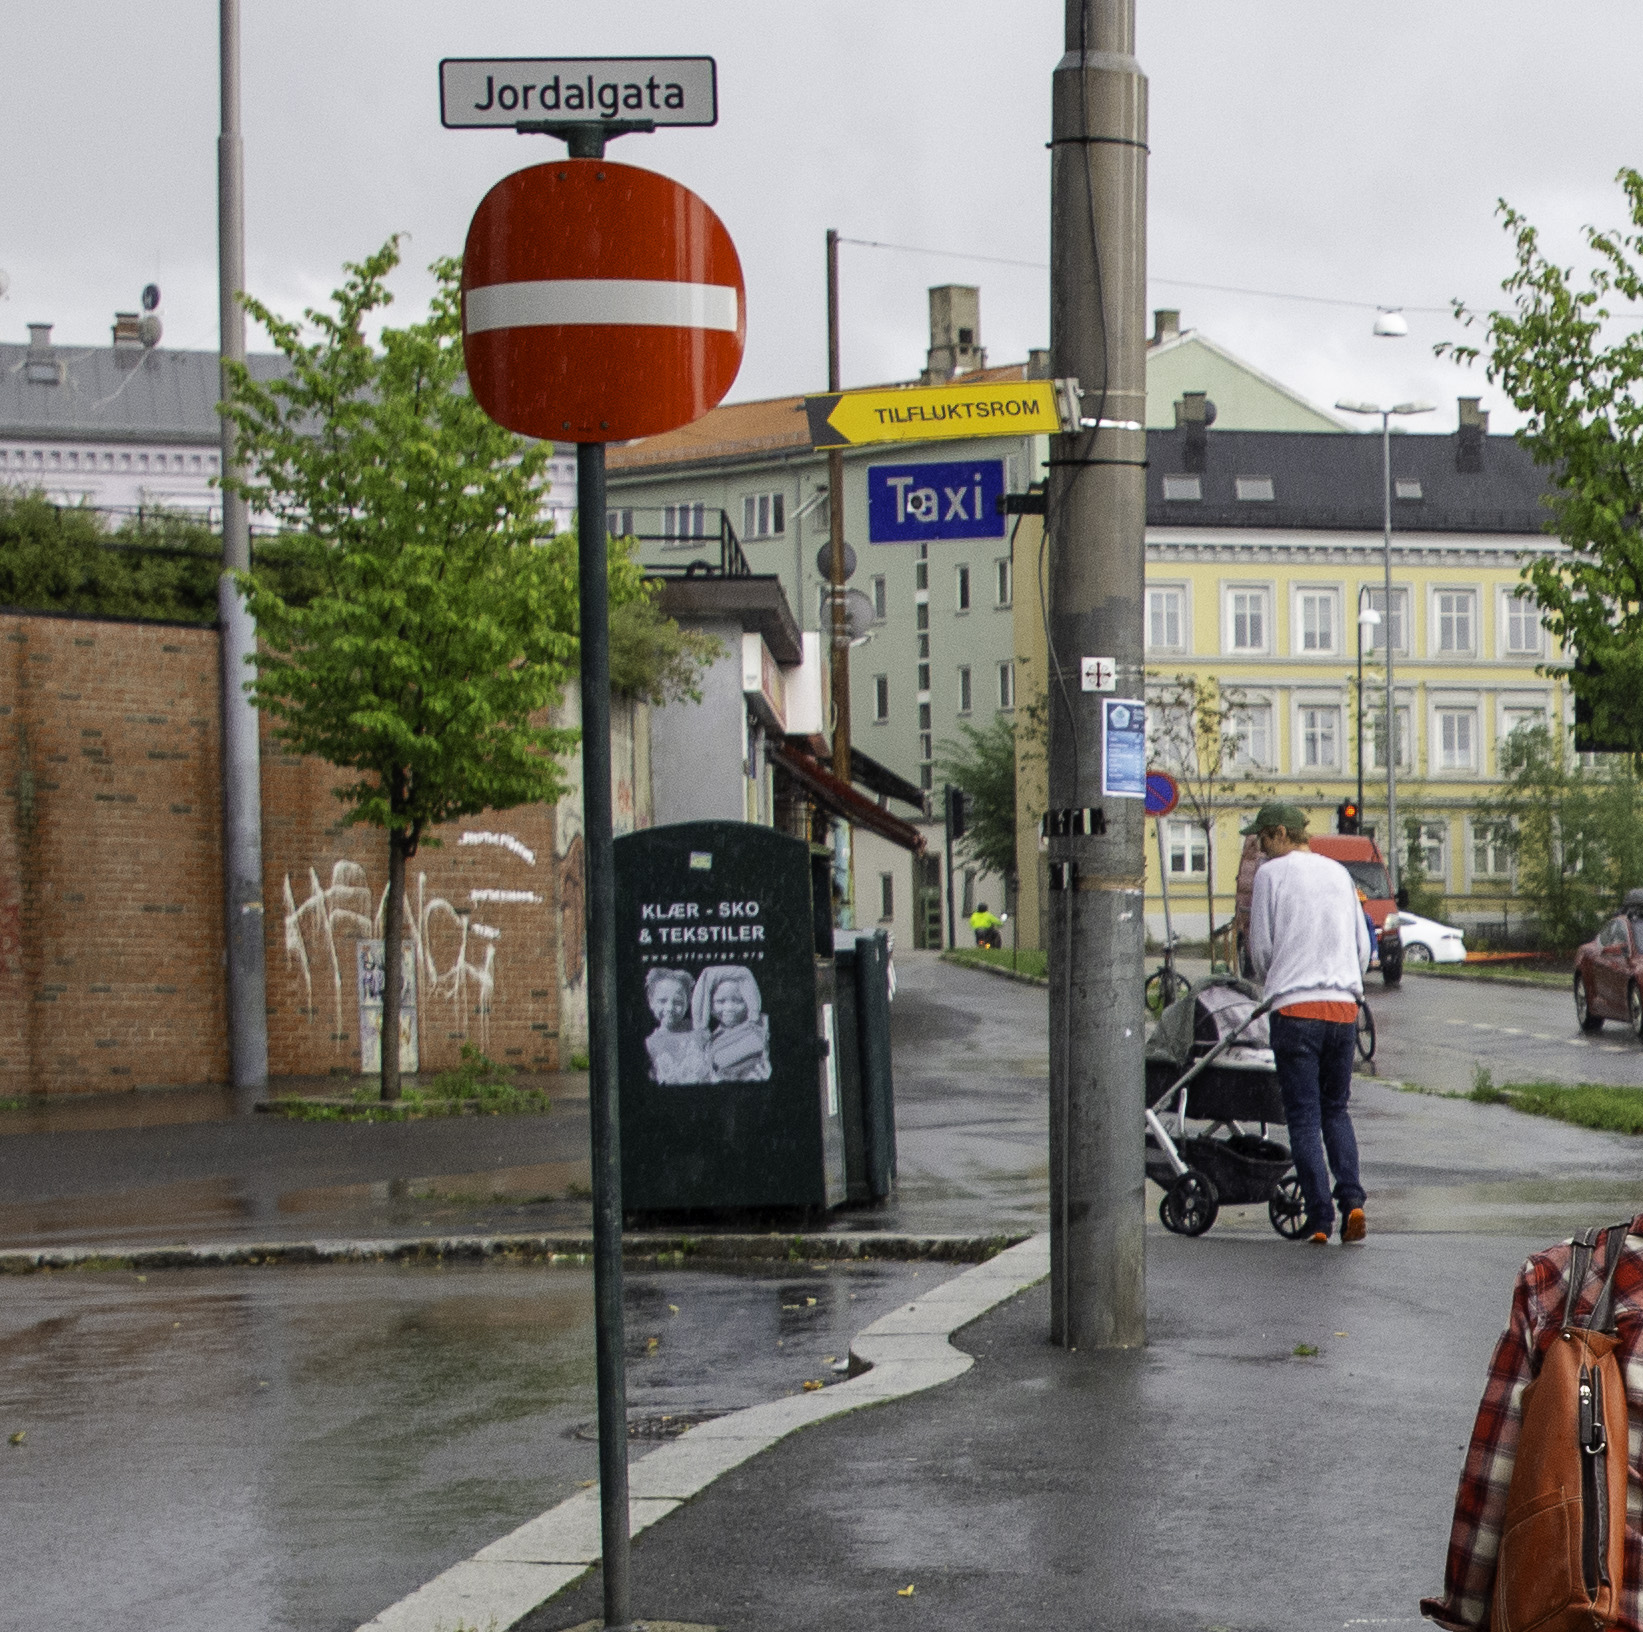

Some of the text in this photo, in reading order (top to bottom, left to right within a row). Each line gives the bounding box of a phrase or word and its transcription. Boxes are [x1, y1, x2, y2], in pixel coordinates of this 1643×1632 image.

[474, 75, 685, 118] Jordalgata
[875, 399, 1040, 424] TILFLUKTSROM
[886, 472, 984, 524] Taxi
[641, 903, 700, 919] KLÆR
[719, 901, 760, 918] SKO
[639, 924, 766, 943] & TEKSTILER
